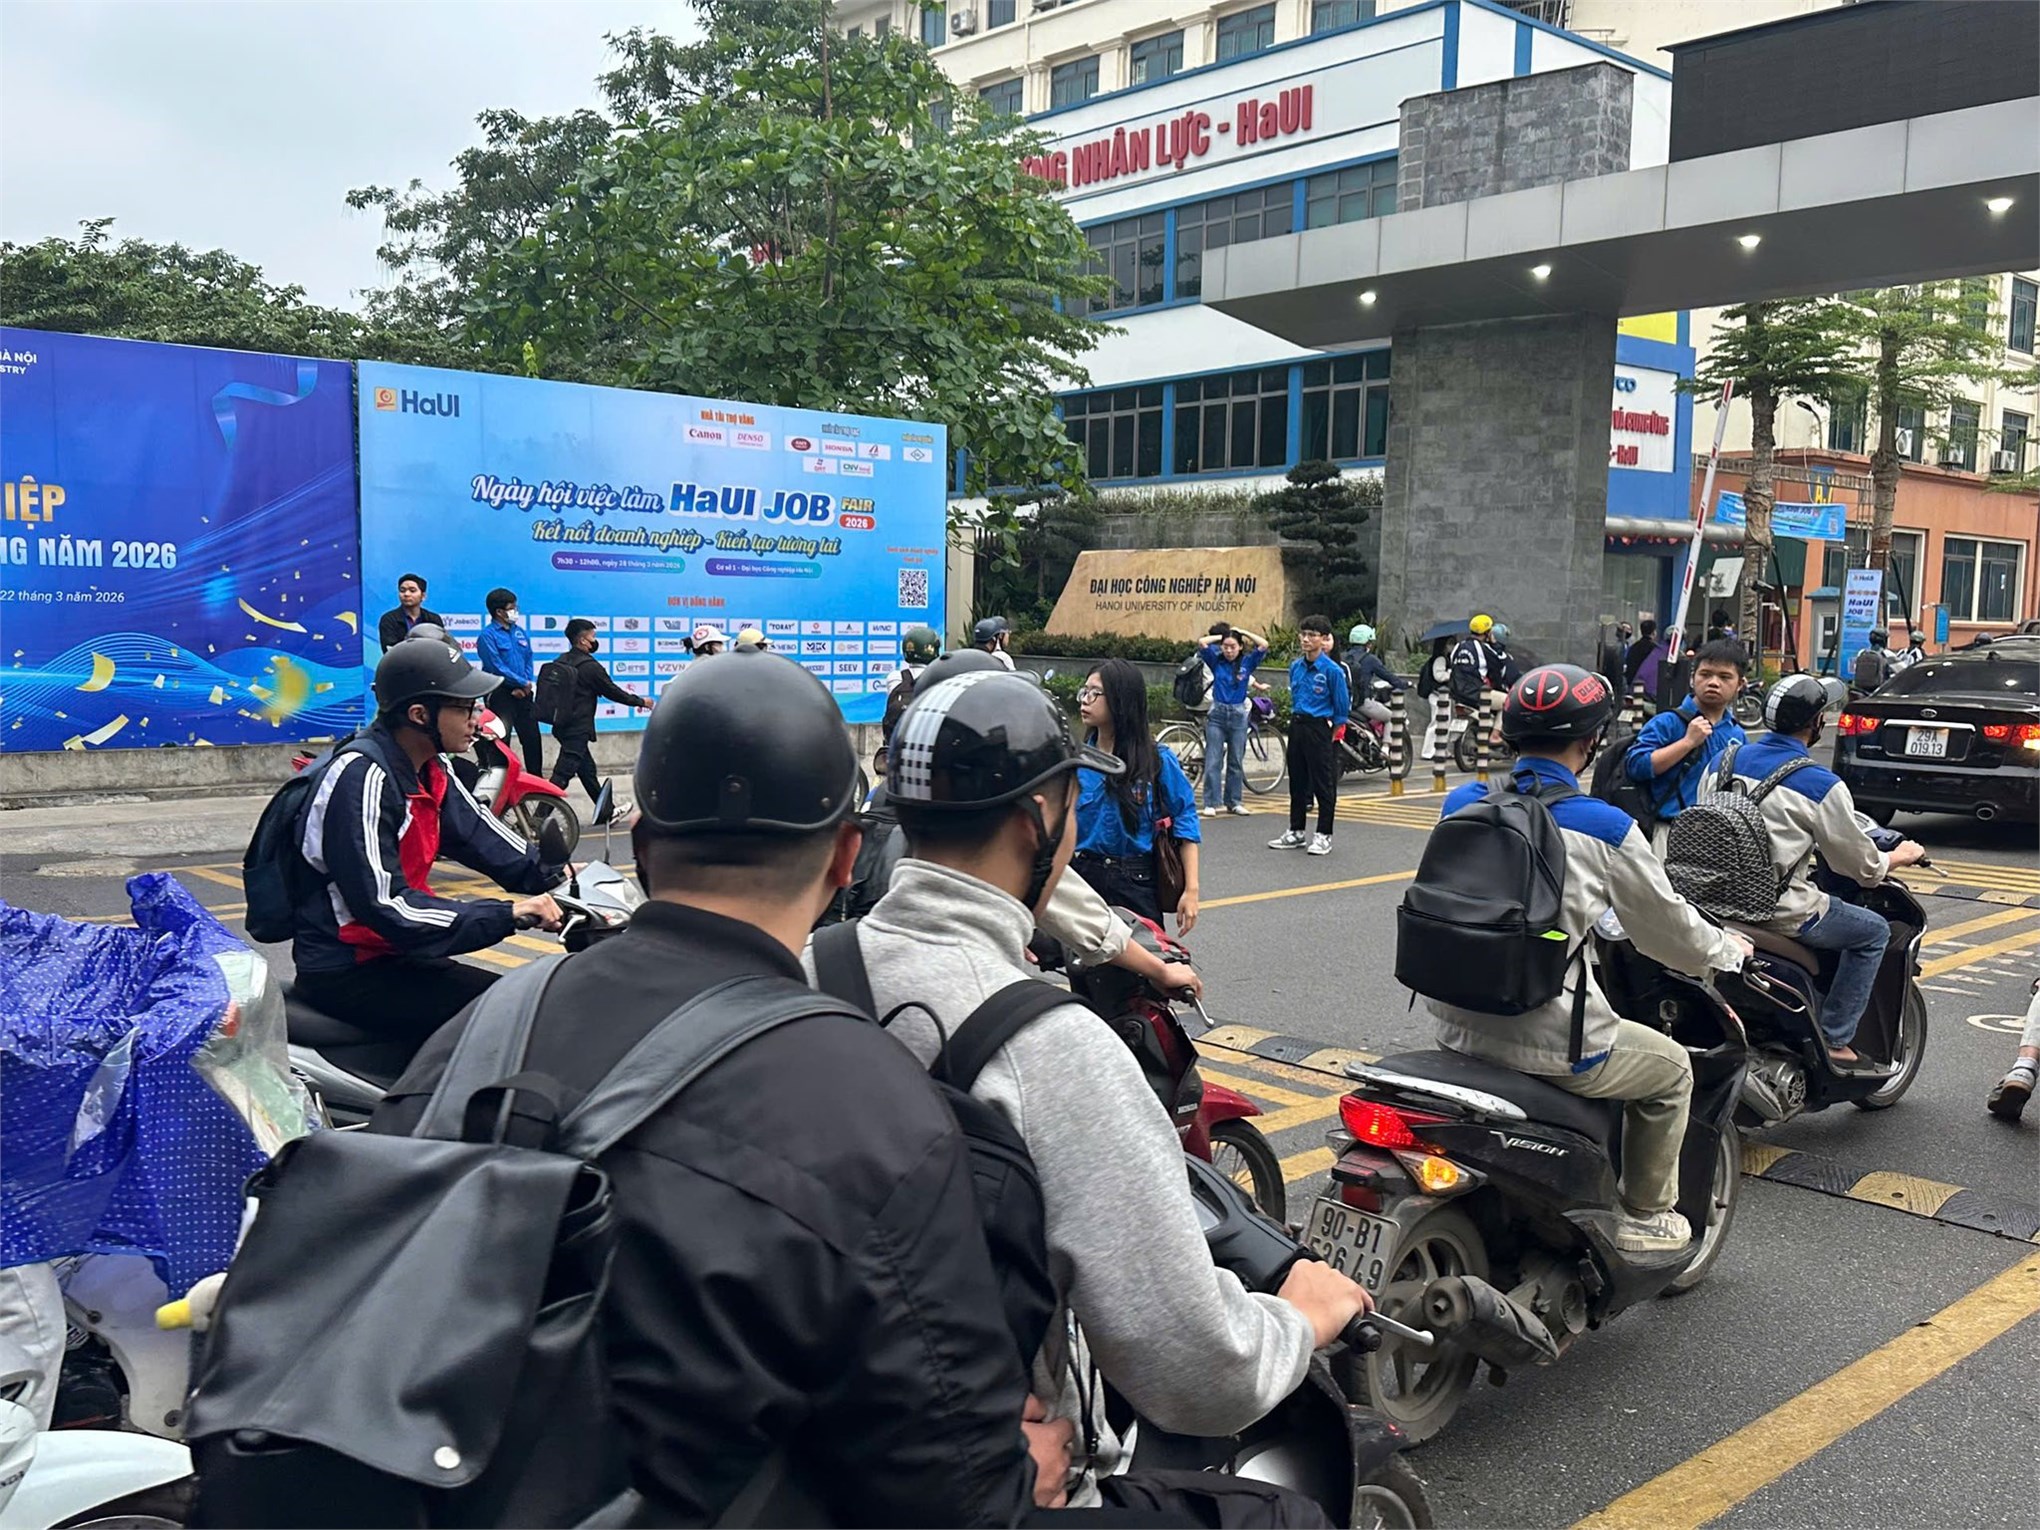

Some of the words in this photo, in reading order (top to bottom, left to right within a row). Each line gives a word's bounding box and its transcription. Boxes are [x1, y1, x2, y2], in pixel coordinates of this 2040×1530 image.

[1072, 126, 1151, 188] NHÂN
[1156, 110, 1211, 170] LỰC
[1217, 121, 1230, 134] -
[1236, 85, 1313, 146] HaUI
[14, 351, 37, 366] NỘI
[401, 389, 460, 418] HaUI
[689, 428, 722, 441] Canon
[737, 433, 764, 443] DENSO
[824, 444, 853, 454] HONDA
[471, 474, 535, 511] Ngày
[537, 480, 574, 511] hội
[576, 483, 618, 514] việc
[619, 485, 664, 512] làm
[669, 482, 757, 516] HaUI
[763, 491, 832, 522] JOB
[841, 497, 875, 513] FAIR
[845, 516, 868, 528] 2026
[532, 518, 564, 541] Kết
[563, 519, 592, 542] nối
[594, 524, 646, 545] doanh
[648, 526, 702, 553] nghiệp
[715, 528, 749, 550] Kiến
[750, 534, 775, 557] tạo
[776, 535, 816, 559] tương
[818, 537, 841, 555] lai
[38, 534, 103, 567] NĂM
[112, 541, 177, 569] 2026
[1090, 578, 1108, 597] ĐẠI
[1111, 578, 1132, 597] HỌC
[1135, 575, 1166, 594] CÔNG
[1169, 574, 1212, 597] NGHIỆP
[1215, 574, 1231, 594] HÀ
[1234, 574, 1257, 597] NỘI
[0, 590, 15, 601] 22
[18, 590, 52, 604] tháng
[56, 591, 63, 602] 3
[66, 592, 92, 602] năm
[95, 592, 125, 603] 2026
[1095, 601, 1123, 611] HANOI
[1125, 601, 1178, 611] UNIVERSITY
[1180, 601, 1192, 611] OF
[1195, 601, 1245, 611] INDUSTRY
[657, 663, 686, 672] YZVN
[838, 663, 858, 672] SEEV
[1916, 729, 1938, 743] 29A
[1910, 742, 1943, 755] 019.13
[1489, 1130, 1570, 1157] VISION
[1321, 1206, 1382, 1253] 90-B1
